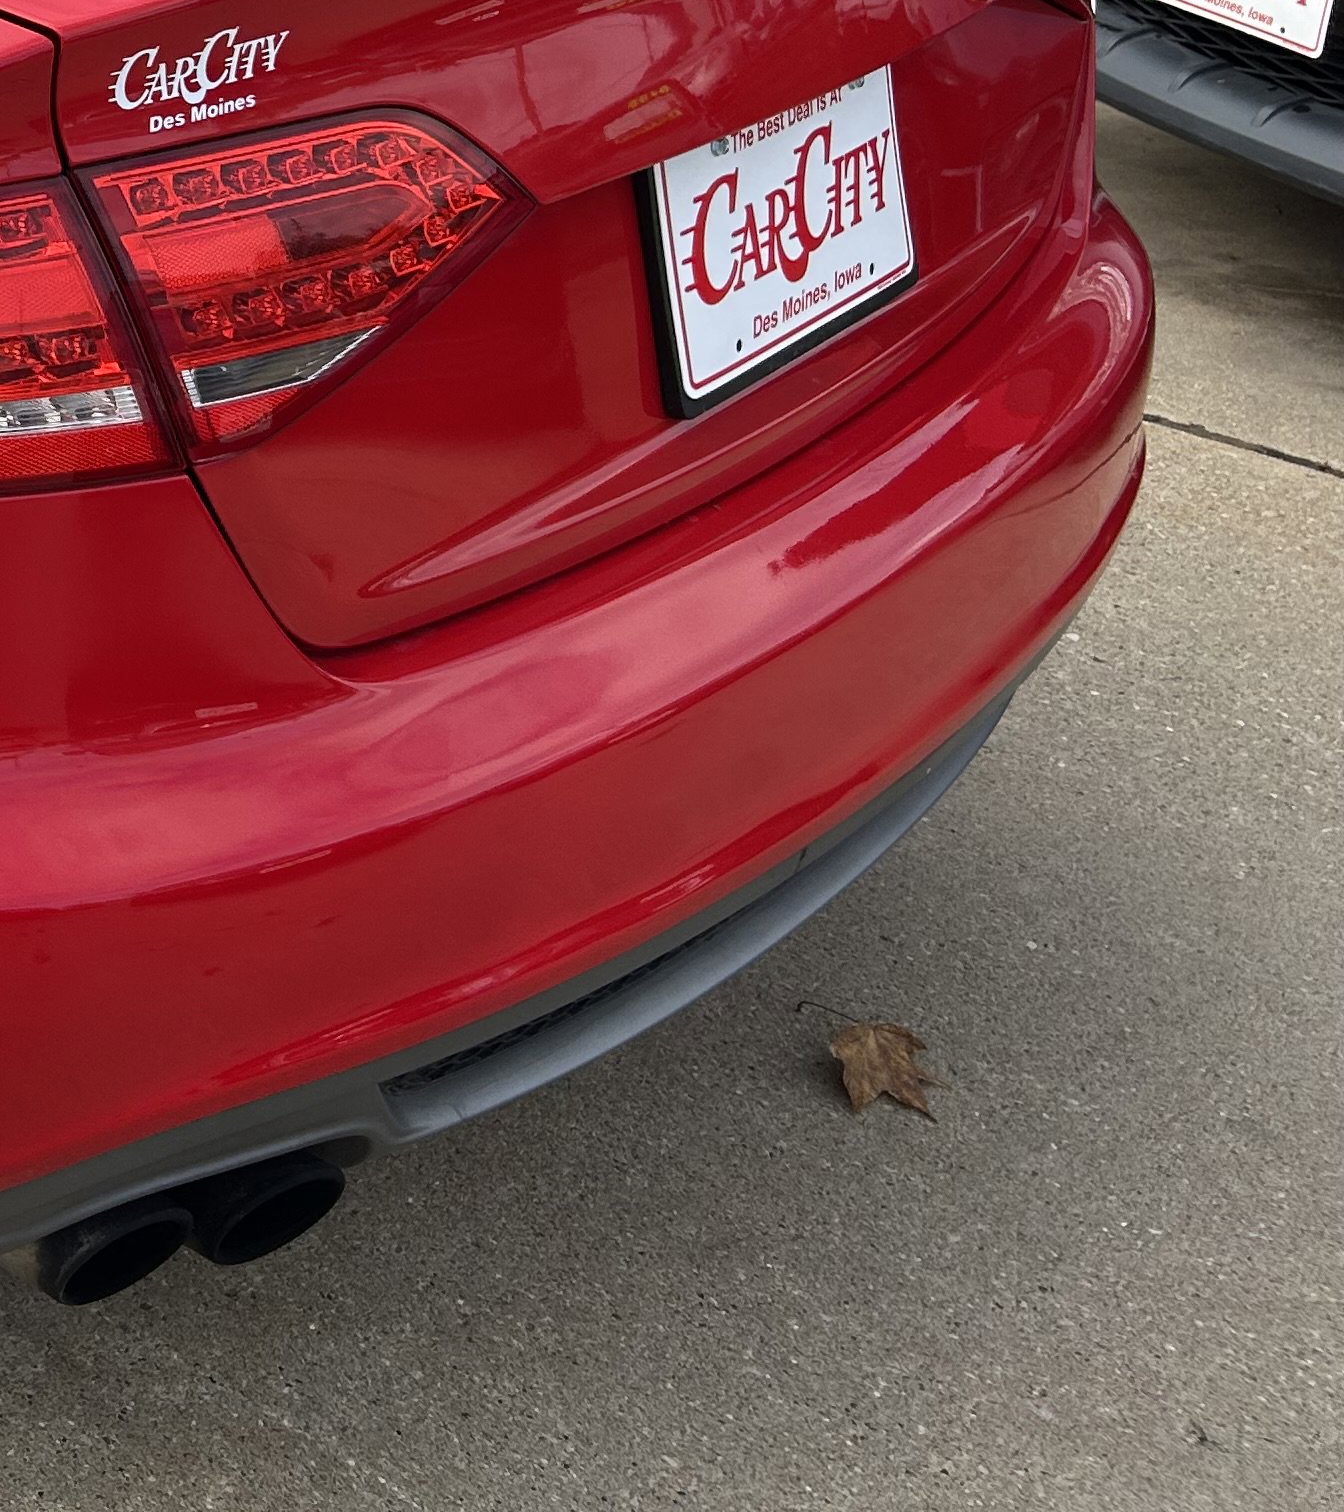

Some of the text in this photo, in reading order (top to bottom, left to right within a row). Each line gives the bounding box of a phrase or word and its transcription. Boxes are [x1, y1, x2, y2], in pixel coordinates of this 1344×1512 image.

[1247, 6, 1274, 26] Iowa
[149, 94, 257, 134] Des Moines
[731, 129, 754, 154] The
[757, 112, 785, 142] Best
[787, 101, 814, 127] Deal
[753, 309, 779, 339] Des
[834, 262, 863, 293] Iowa
